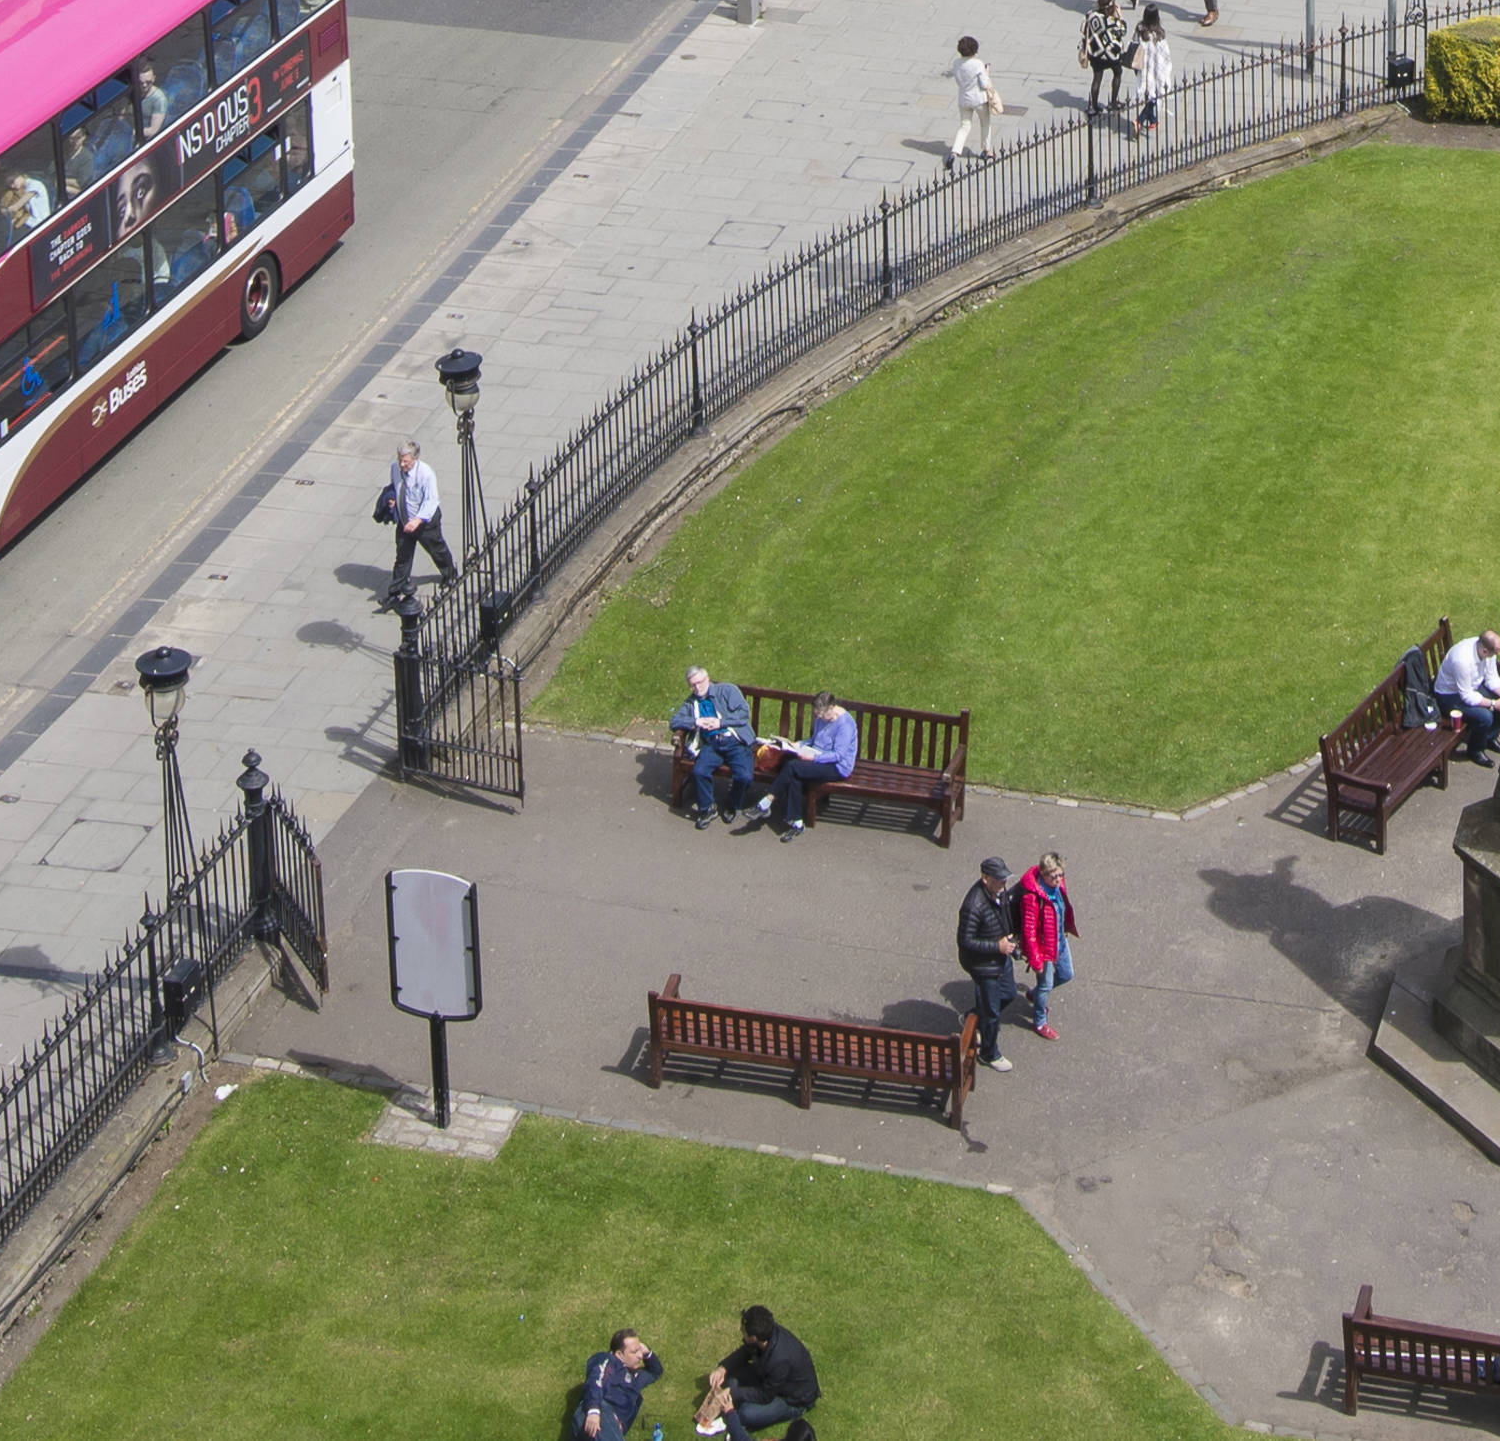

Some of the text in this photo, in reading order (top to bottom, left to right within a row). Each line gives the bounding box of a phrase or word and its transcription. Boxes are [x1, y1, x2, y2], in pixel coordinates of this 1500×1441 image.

[247, 75, 263, 125] 3
[215, 114, 250, 154] CHAPTER
[48, 222, 92, 262] CHAPTER GOES
[50, 233, 62, 250] THE
[58, 239, 84, 265] BACK TO
[109, 368, 148, 415] Buses
